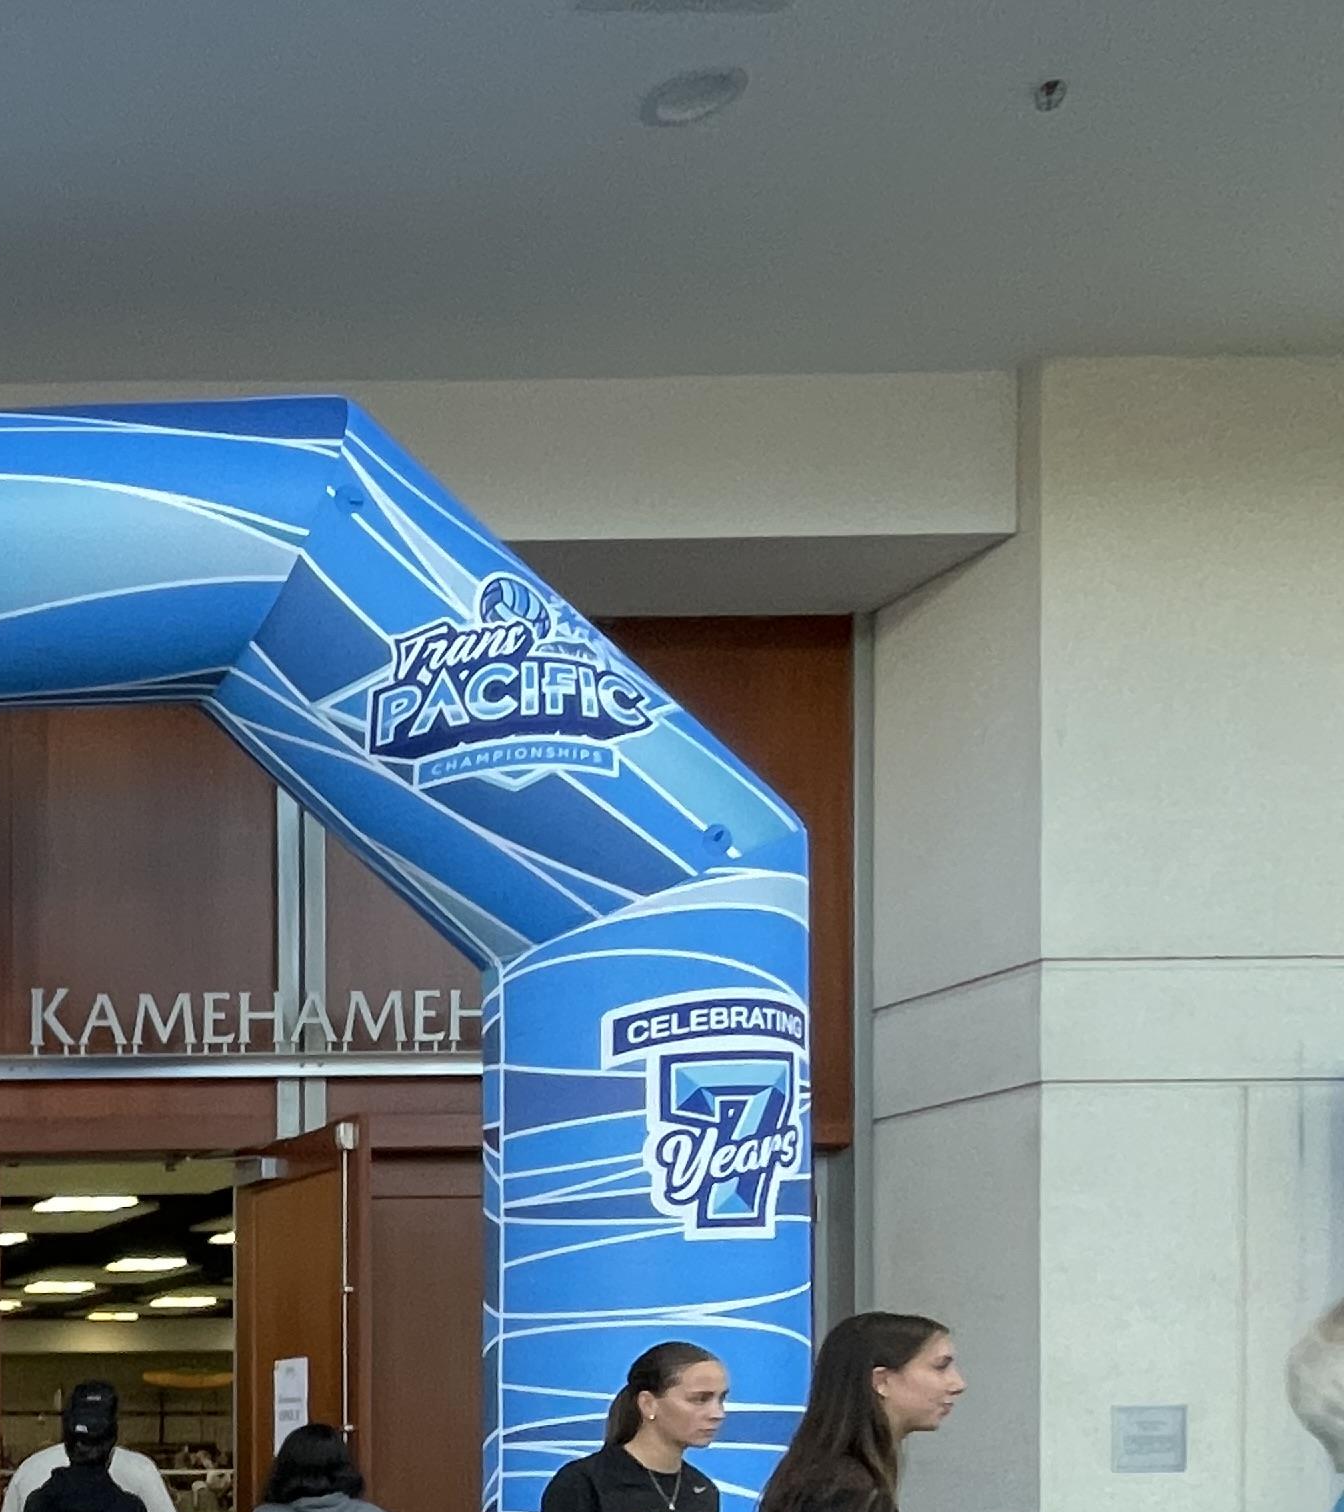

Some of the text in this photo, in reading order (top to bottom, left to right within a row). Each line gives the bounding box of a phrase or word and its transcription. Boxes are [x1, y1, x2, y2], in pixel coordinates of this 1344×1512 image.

[399, 620, 525, 680] Trans
[375, 660, 648, 747] PACIFIC
[430, 749, 603, 776] CHAMPIONSHIPS
[626, 1006, 803, 1045] CELEBRATING
[659, 1051, 794, 1230] 7
[661, 1126, 797, 1201] Years
